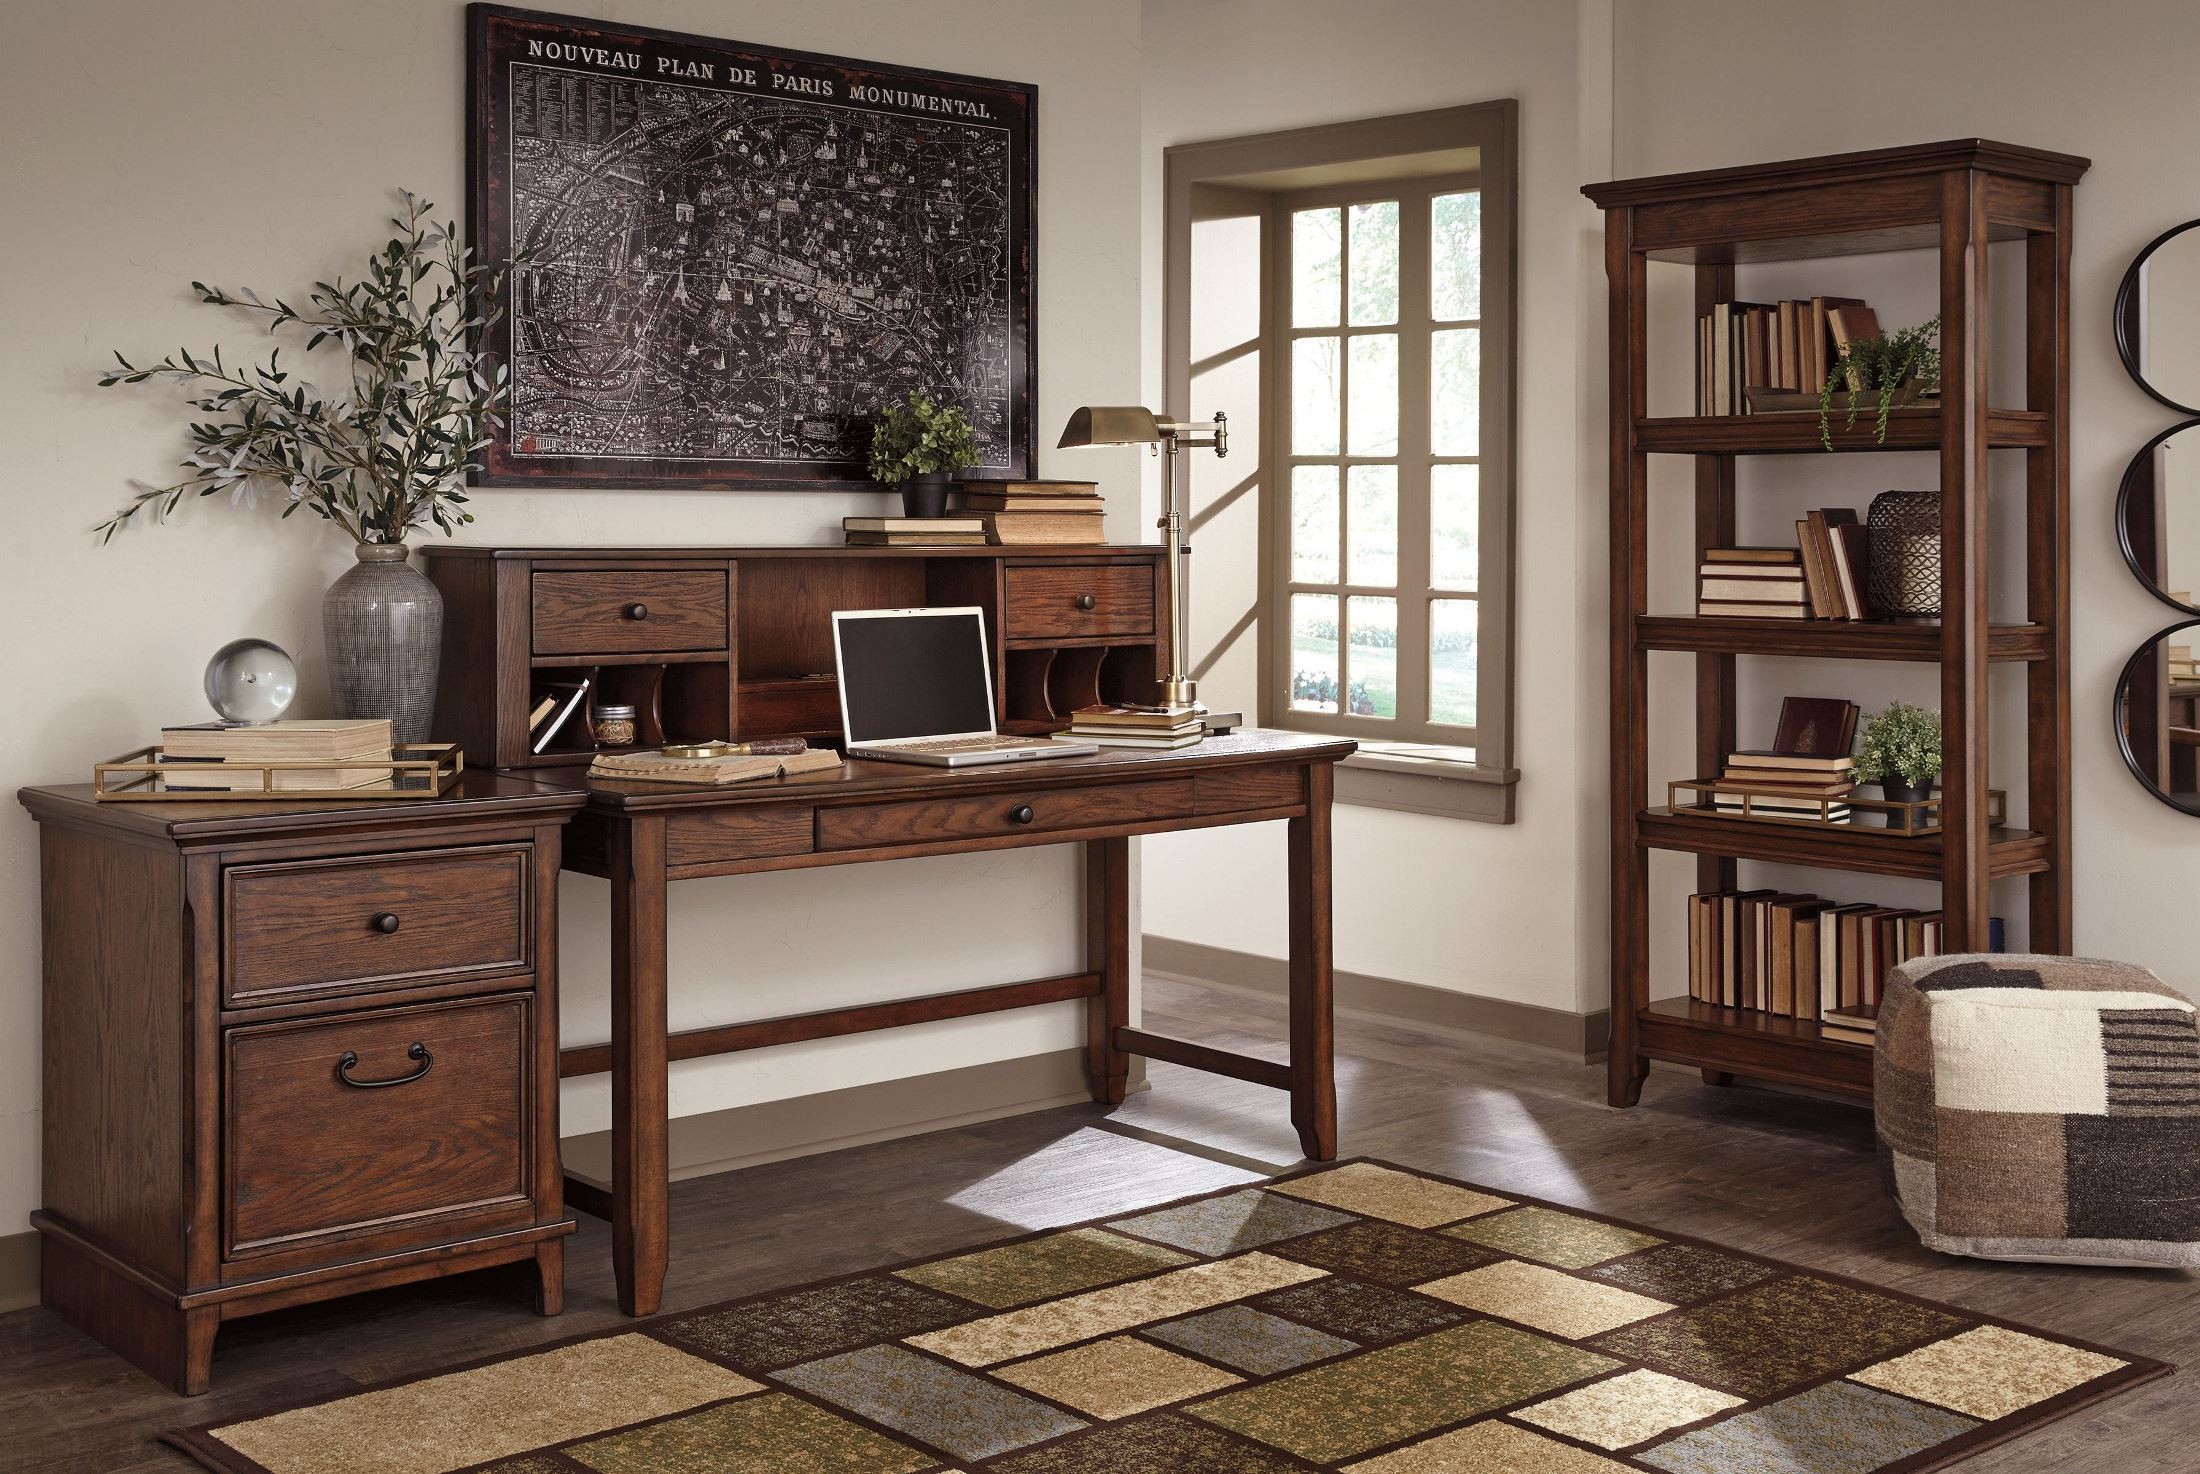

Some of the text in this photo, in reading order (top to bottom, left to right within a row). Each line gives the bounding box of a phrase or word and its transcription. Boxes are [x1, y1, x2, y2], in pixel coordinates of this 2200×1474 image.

[528, 39, 998, 120] NOUVEAU PLAN DE PARIS MONUMENTAL.
